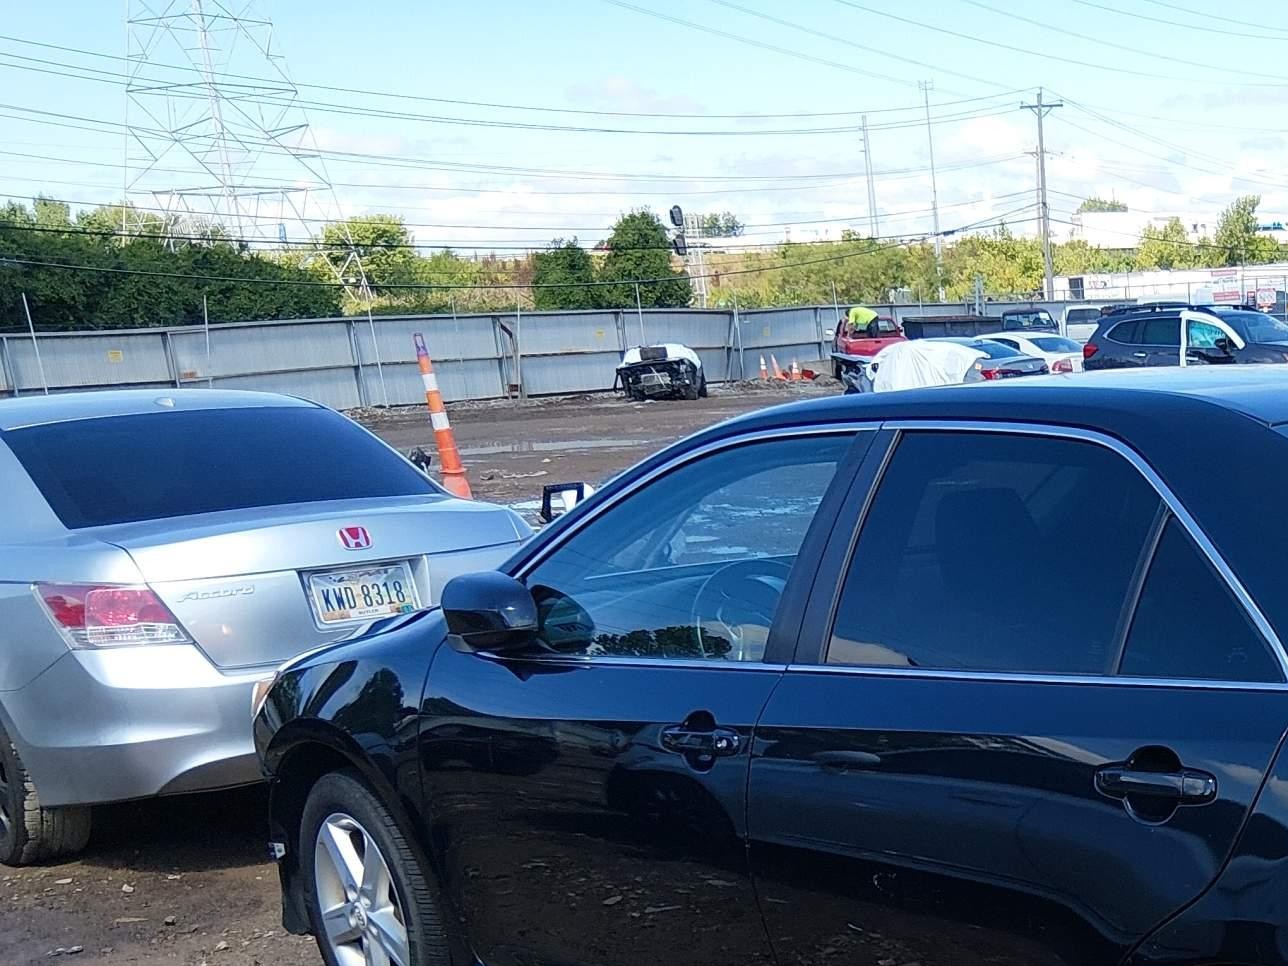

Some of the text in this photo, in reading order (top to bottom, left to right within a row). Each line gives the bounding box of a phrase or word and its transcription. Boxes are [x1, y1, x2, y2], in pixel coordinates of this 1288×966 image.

[176, 583, 256, 603] Accord
[321, 580, 406, 612] KWD 8318
